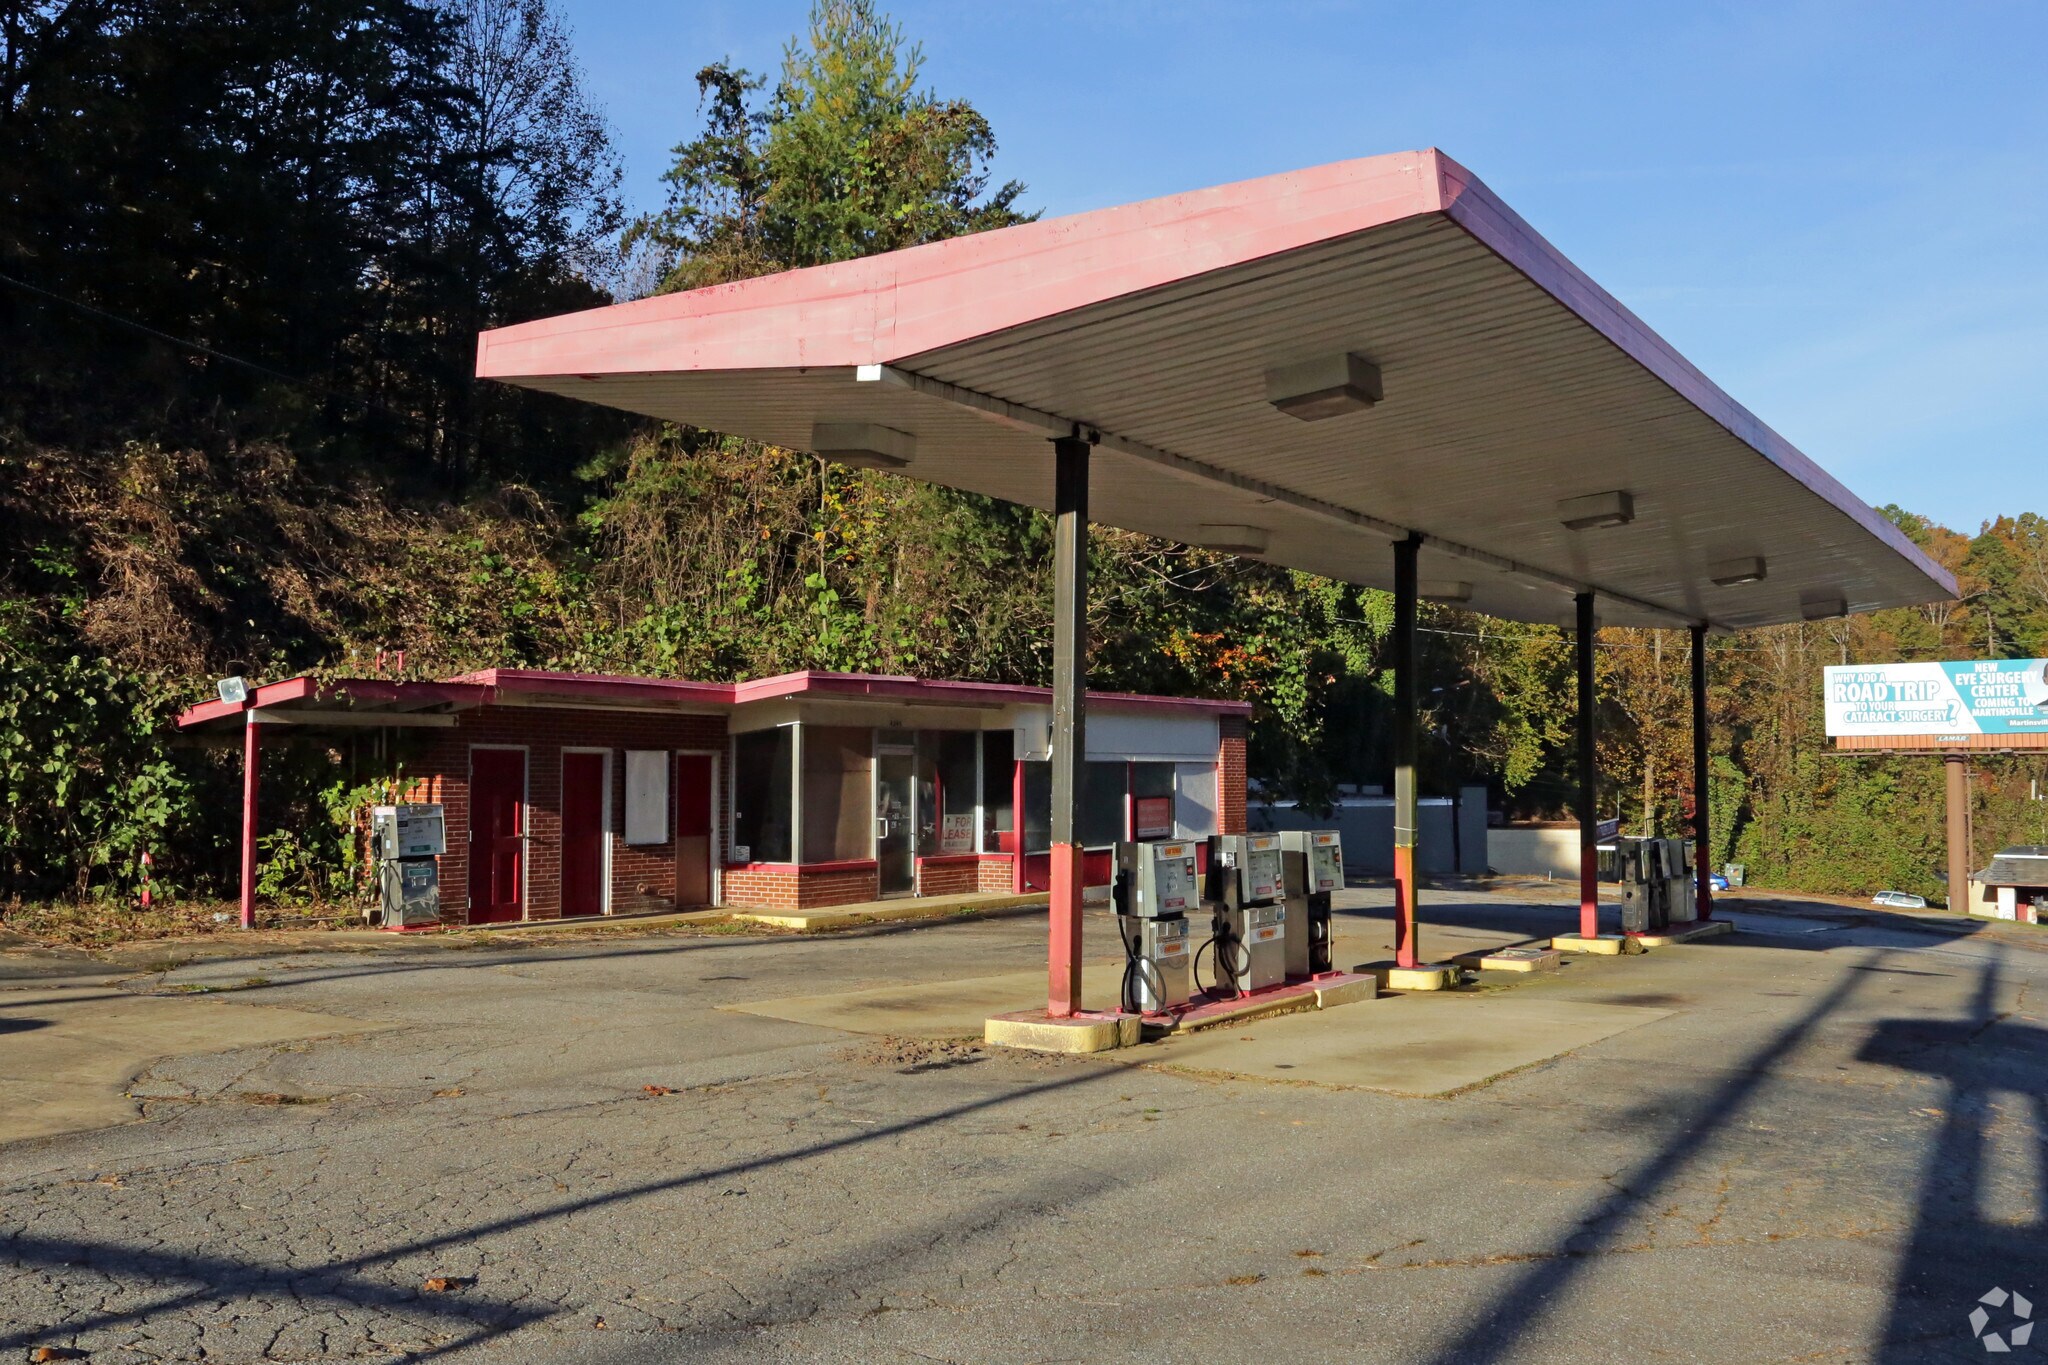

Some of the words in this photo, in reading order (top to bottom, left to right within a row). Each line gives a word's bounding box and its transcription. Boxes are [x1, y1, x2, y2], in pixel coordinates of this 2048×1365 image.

[1974, 662, 1998, 672] NEW
[1833, 673, 1856, 683] WHY
[1857, 672, 1877, 683] ADD
[1878, 672, 1886, 682] A
[1955, 673, 1977, 685] EYE
[1979, 670, 2038, 684] SURGERY
[1834, 683, 1888, 702] ROAD
[1891, 680, 1941, 701] TRIP
[1970, 684, 2019, 697] CENTER
[1855, 702, 1867, 711] TO
[1869, 701, 1896, 711] YOUR
[1974, 697, 2015, 708] COMING
[2017, 697, 2031, 706] TO
[1844, 711, 1896, 723] CATARACT
[1972, 707, 2034, 716] MARTINSVILLE
[2009, 718, 2048, 727] Martinsvill
[955, 816, 972, 827] FOR
